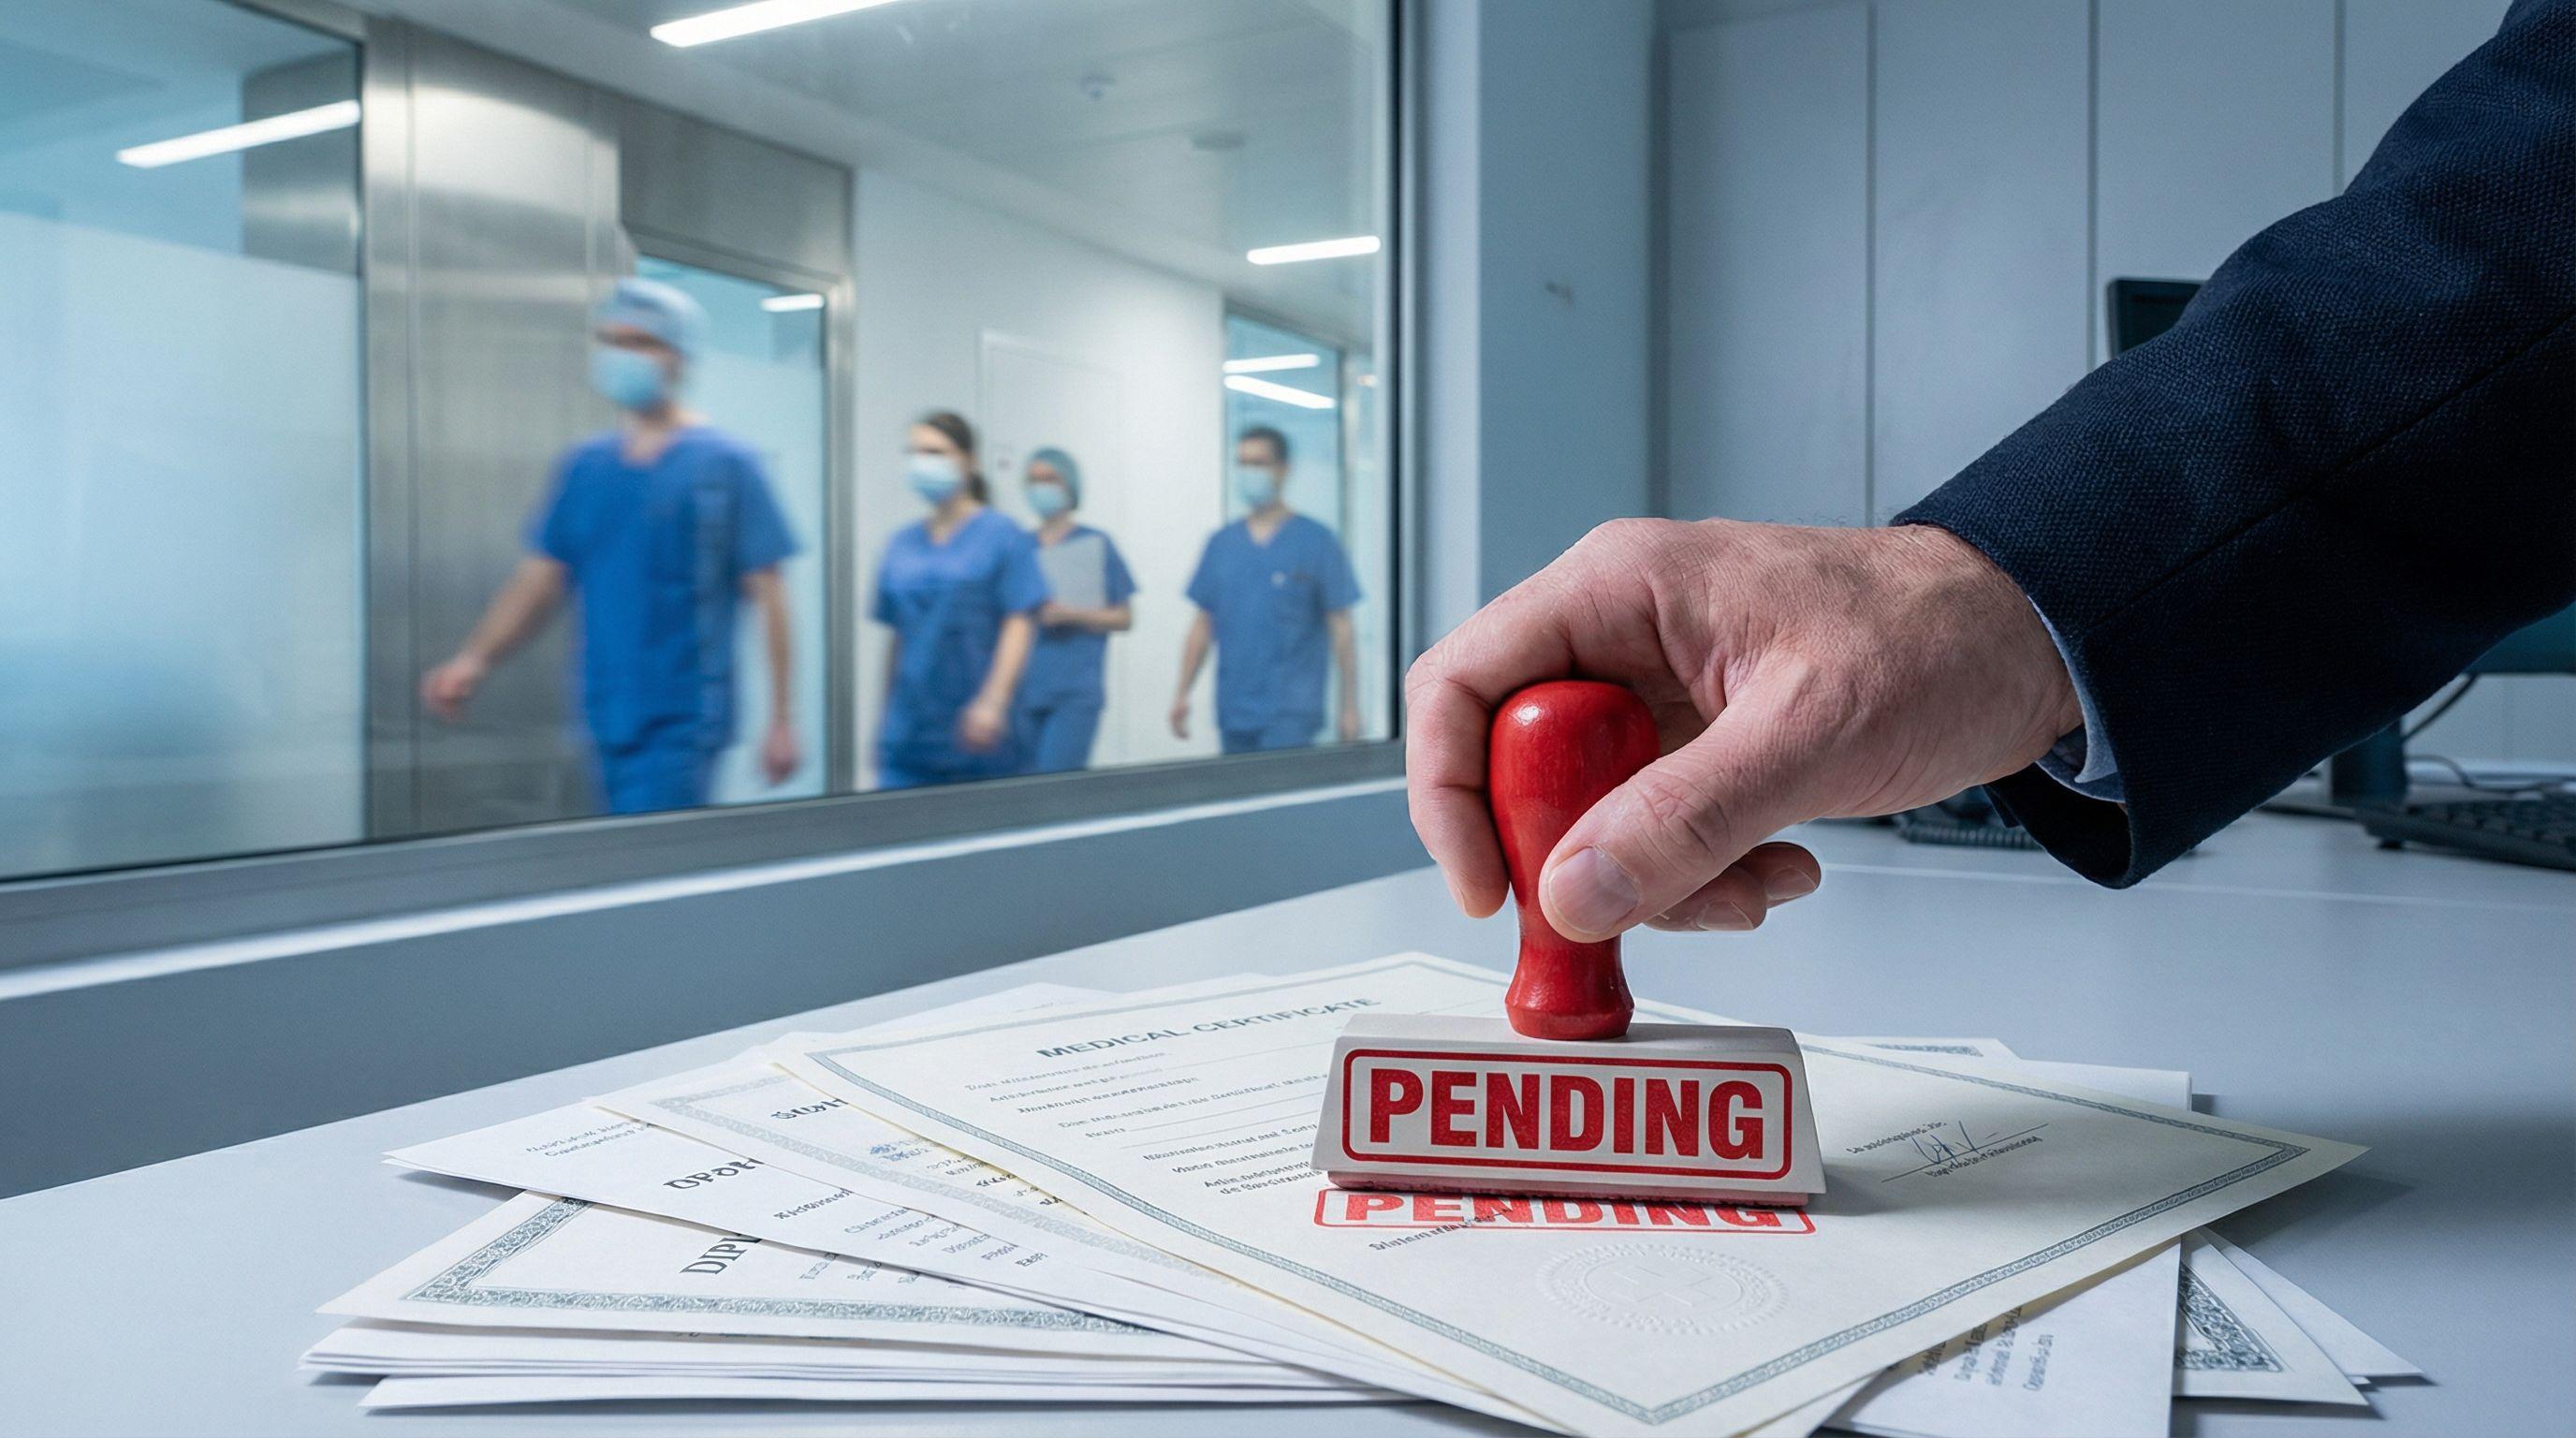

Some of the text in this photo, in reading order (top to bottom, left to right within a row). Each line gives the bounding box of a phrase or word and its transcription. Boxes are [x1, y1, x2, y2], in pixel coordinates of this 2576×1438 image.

[1036, 998, 1381, 1058] MEDICAL CERTIFICATE
[1368, 1067, 1764, 1160] PENDING
[1345, 1193, 1782, 1227] PENDING
